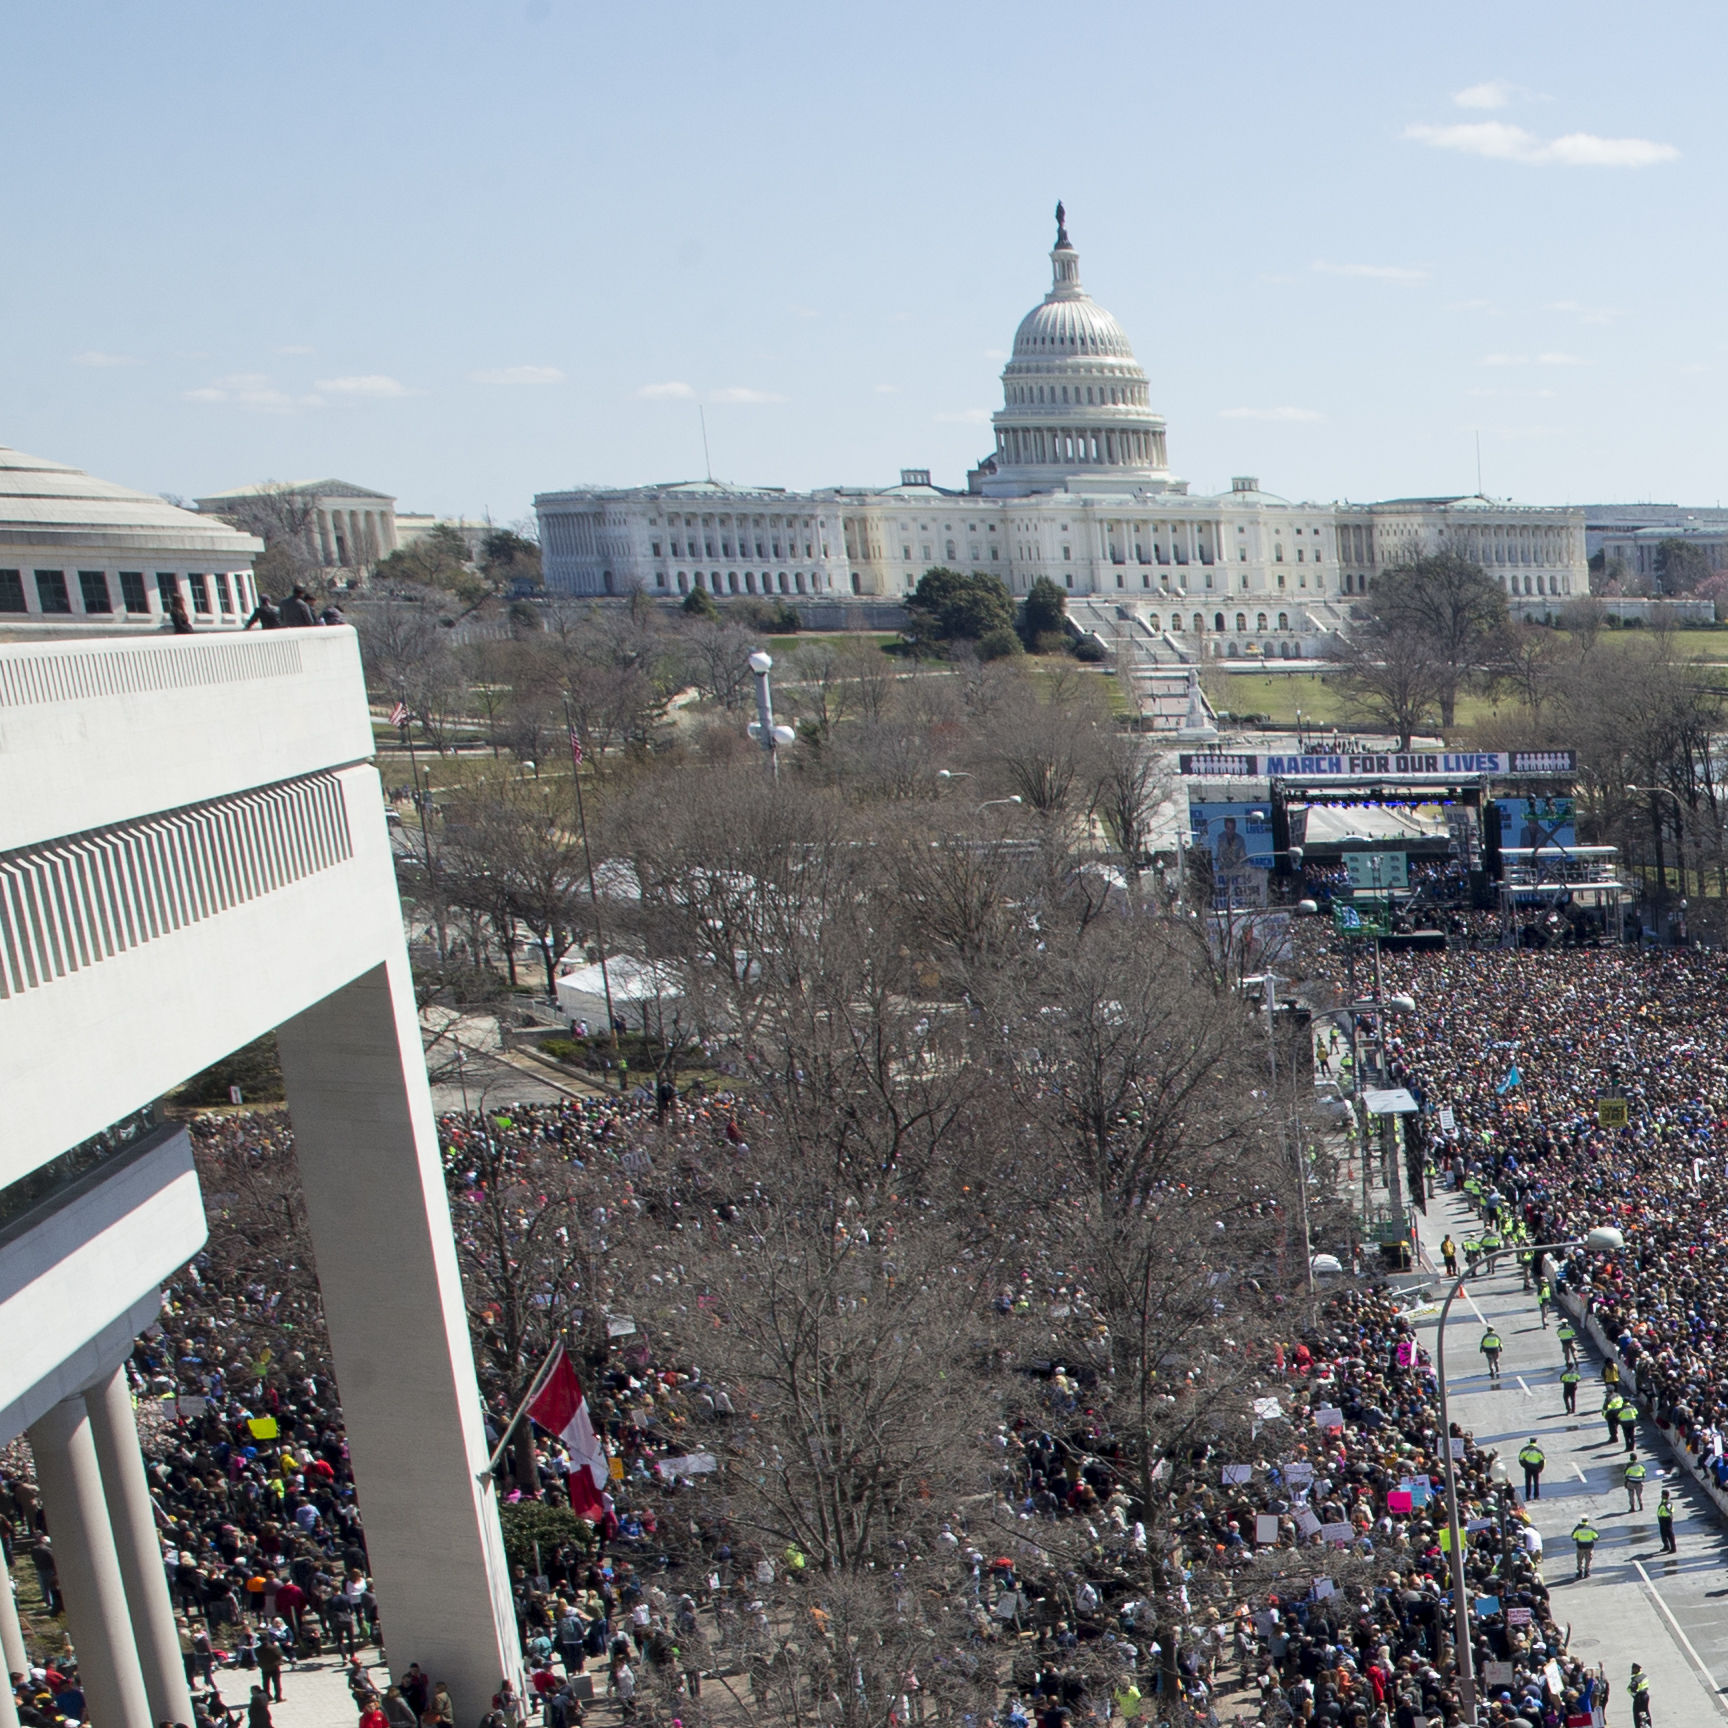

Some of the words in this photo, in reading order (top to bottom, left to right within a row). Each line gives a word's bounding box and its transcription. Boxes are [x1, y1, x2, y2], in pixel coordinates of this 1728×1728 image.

[1267, 757, 1342, 774] MARCH
[1349, 756, 1390, 774] FOR
[1396, 755, 1439, 773] OUR
[1443, 753, 1500, 772] LIVES
